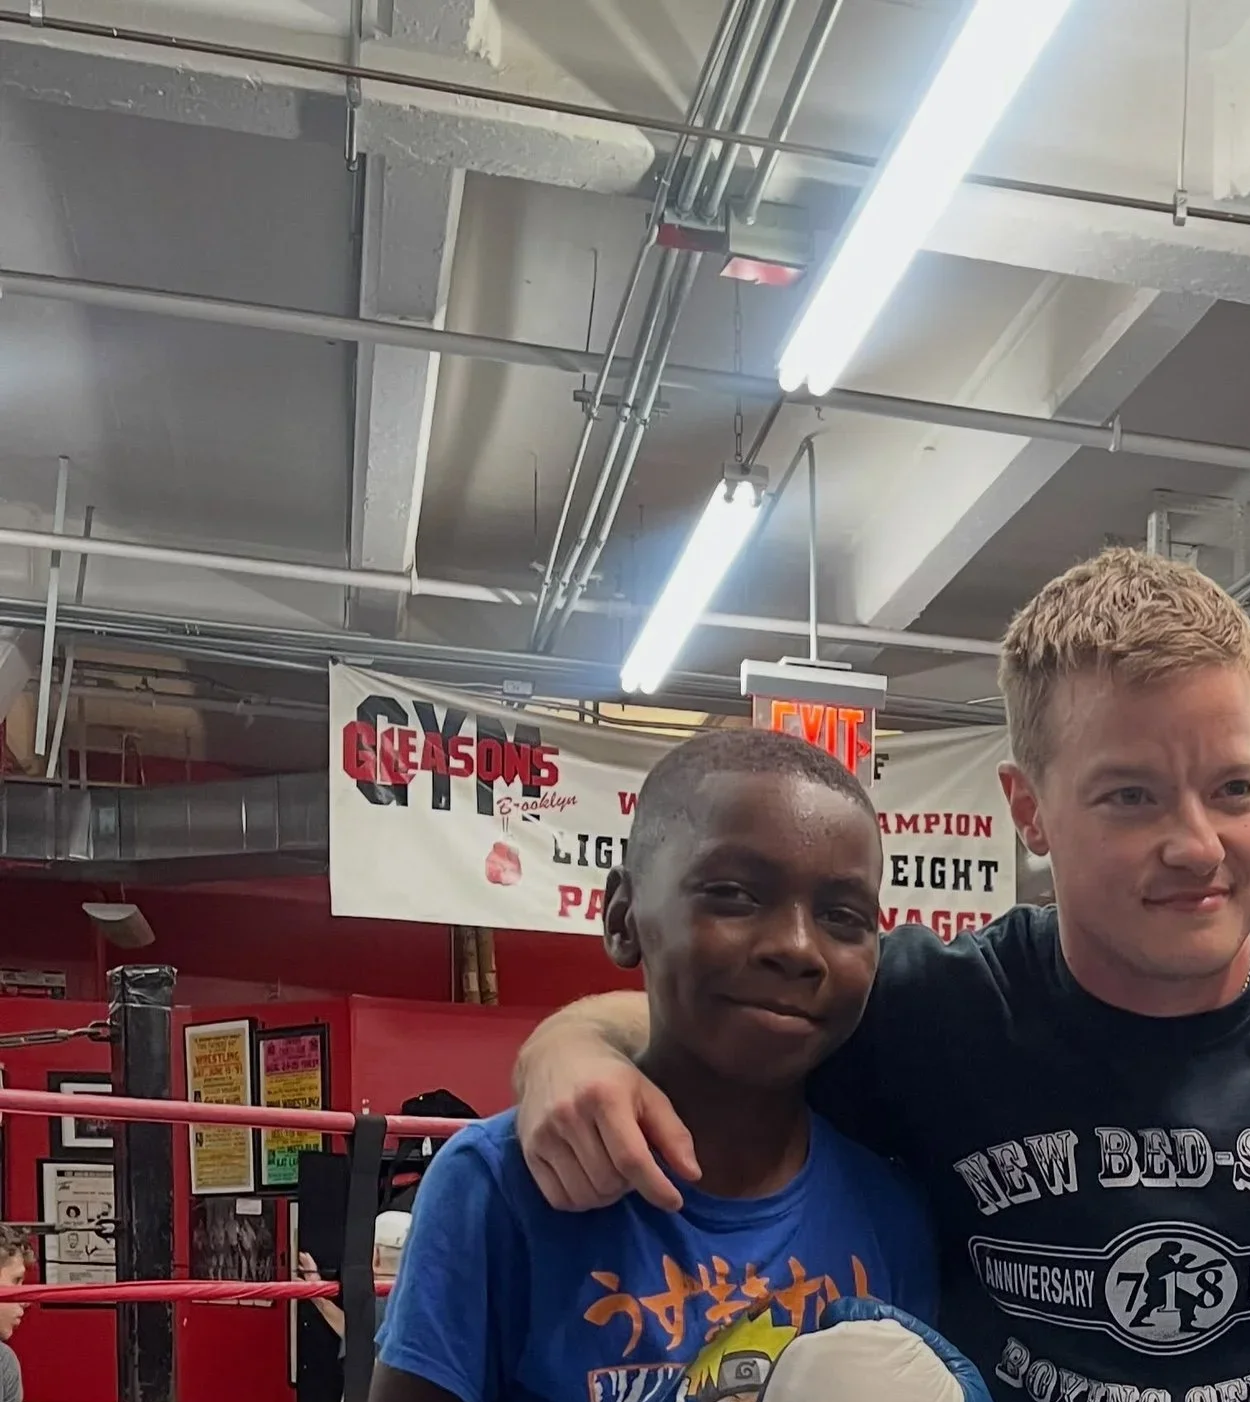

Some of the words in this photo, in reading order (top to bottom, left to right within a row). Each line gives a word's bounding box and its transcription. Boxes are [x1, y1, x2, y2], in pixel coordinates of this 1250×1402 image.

[496, 792, 578, 816] Brooklyn
[953, 1130, 1079, 1216] NEW
[984, 1256, 1096, 1308] ANNIVERSARY
[1116, 1267, 1225, 1314] 718
